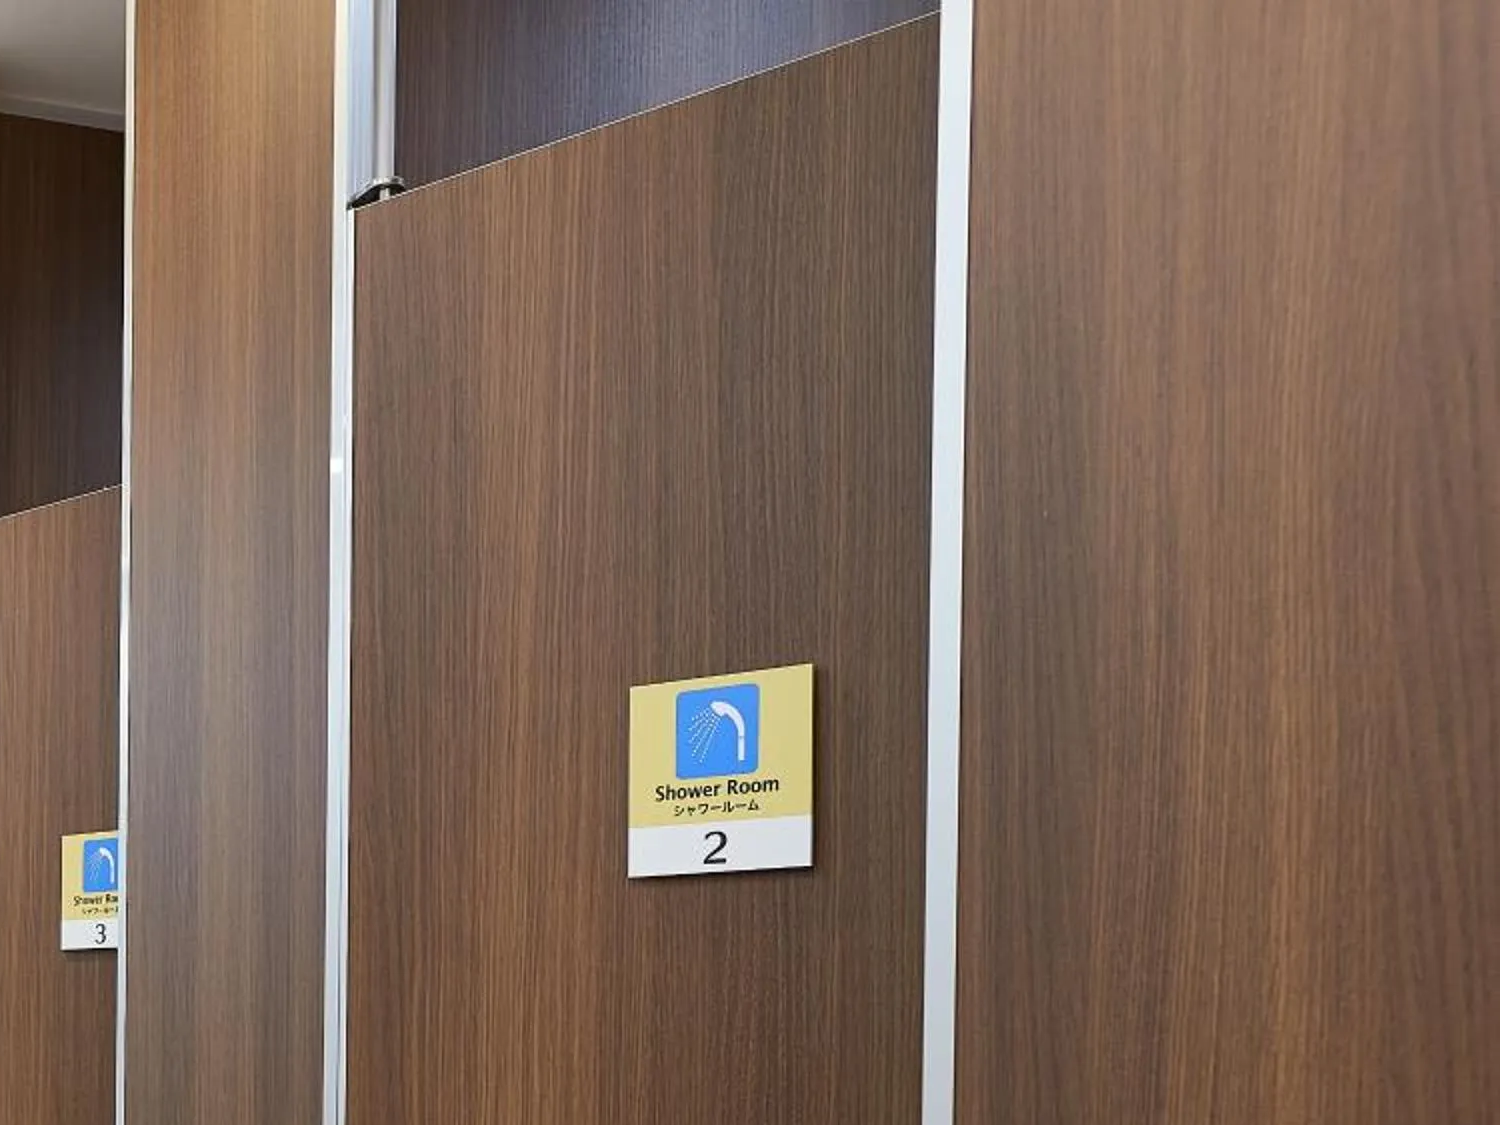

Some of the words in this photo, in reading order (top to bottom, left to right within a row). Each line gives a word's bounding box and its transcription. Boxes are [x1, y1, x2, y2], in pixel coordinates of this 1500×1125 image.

[655, 784, 720, 802] Shower
[727, 779, 779, 795] Room
[674, 799, 759, 816] シャワールーム
[703, 831, 727, 864] 2
[95, 923, 107, 945] 3
